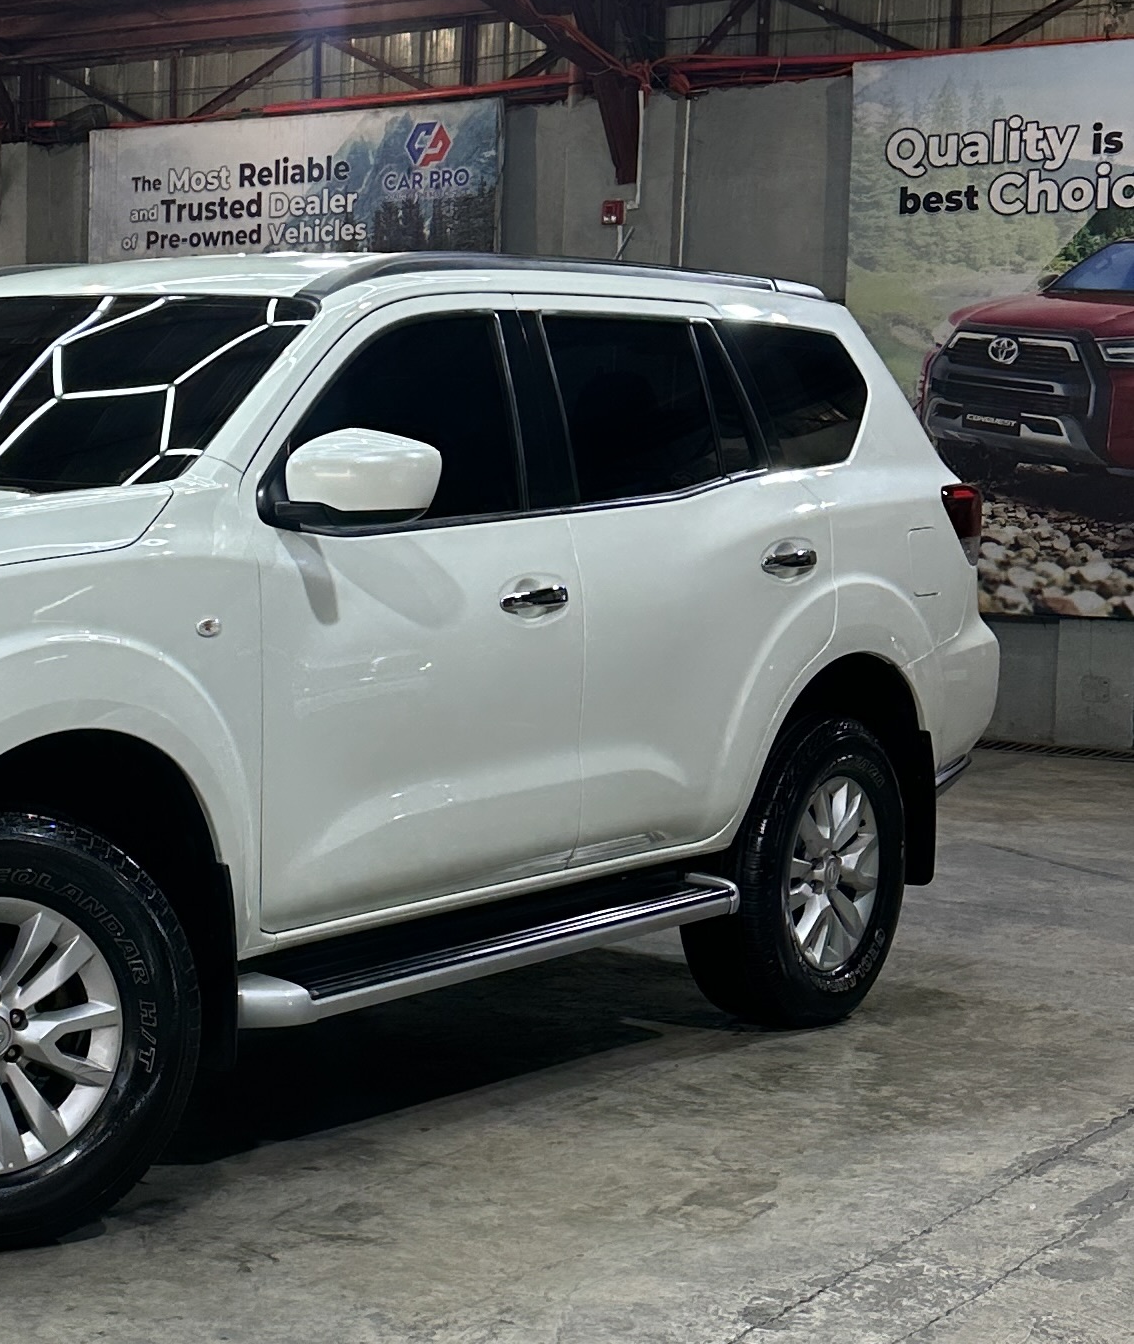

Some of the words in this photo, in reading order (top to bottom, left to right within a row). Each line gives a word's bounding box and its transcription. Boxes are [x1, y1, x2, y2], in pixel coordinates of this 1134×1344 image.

[885, 114, 1080, 178] Quality
[1092, 122, 1124, 155] is
[131, 176, 162, 193] The
[167, 165, 231, 194] Most
[239, 155, 350, 187] Reliable
[383, 171, 423, 192] CAR
[429, 167, 470, 189] PRO
[129, 205, 158, 223] and
[161, 192, 263, 223] Trusted
[268, 188, 358, 218] Dealer
[899, 185, 979, 215] best
[121, 233, 138, 250] of
[146, 223, 262, 250] Pre-owned
[267, 219, 367, 245] Vehicles
